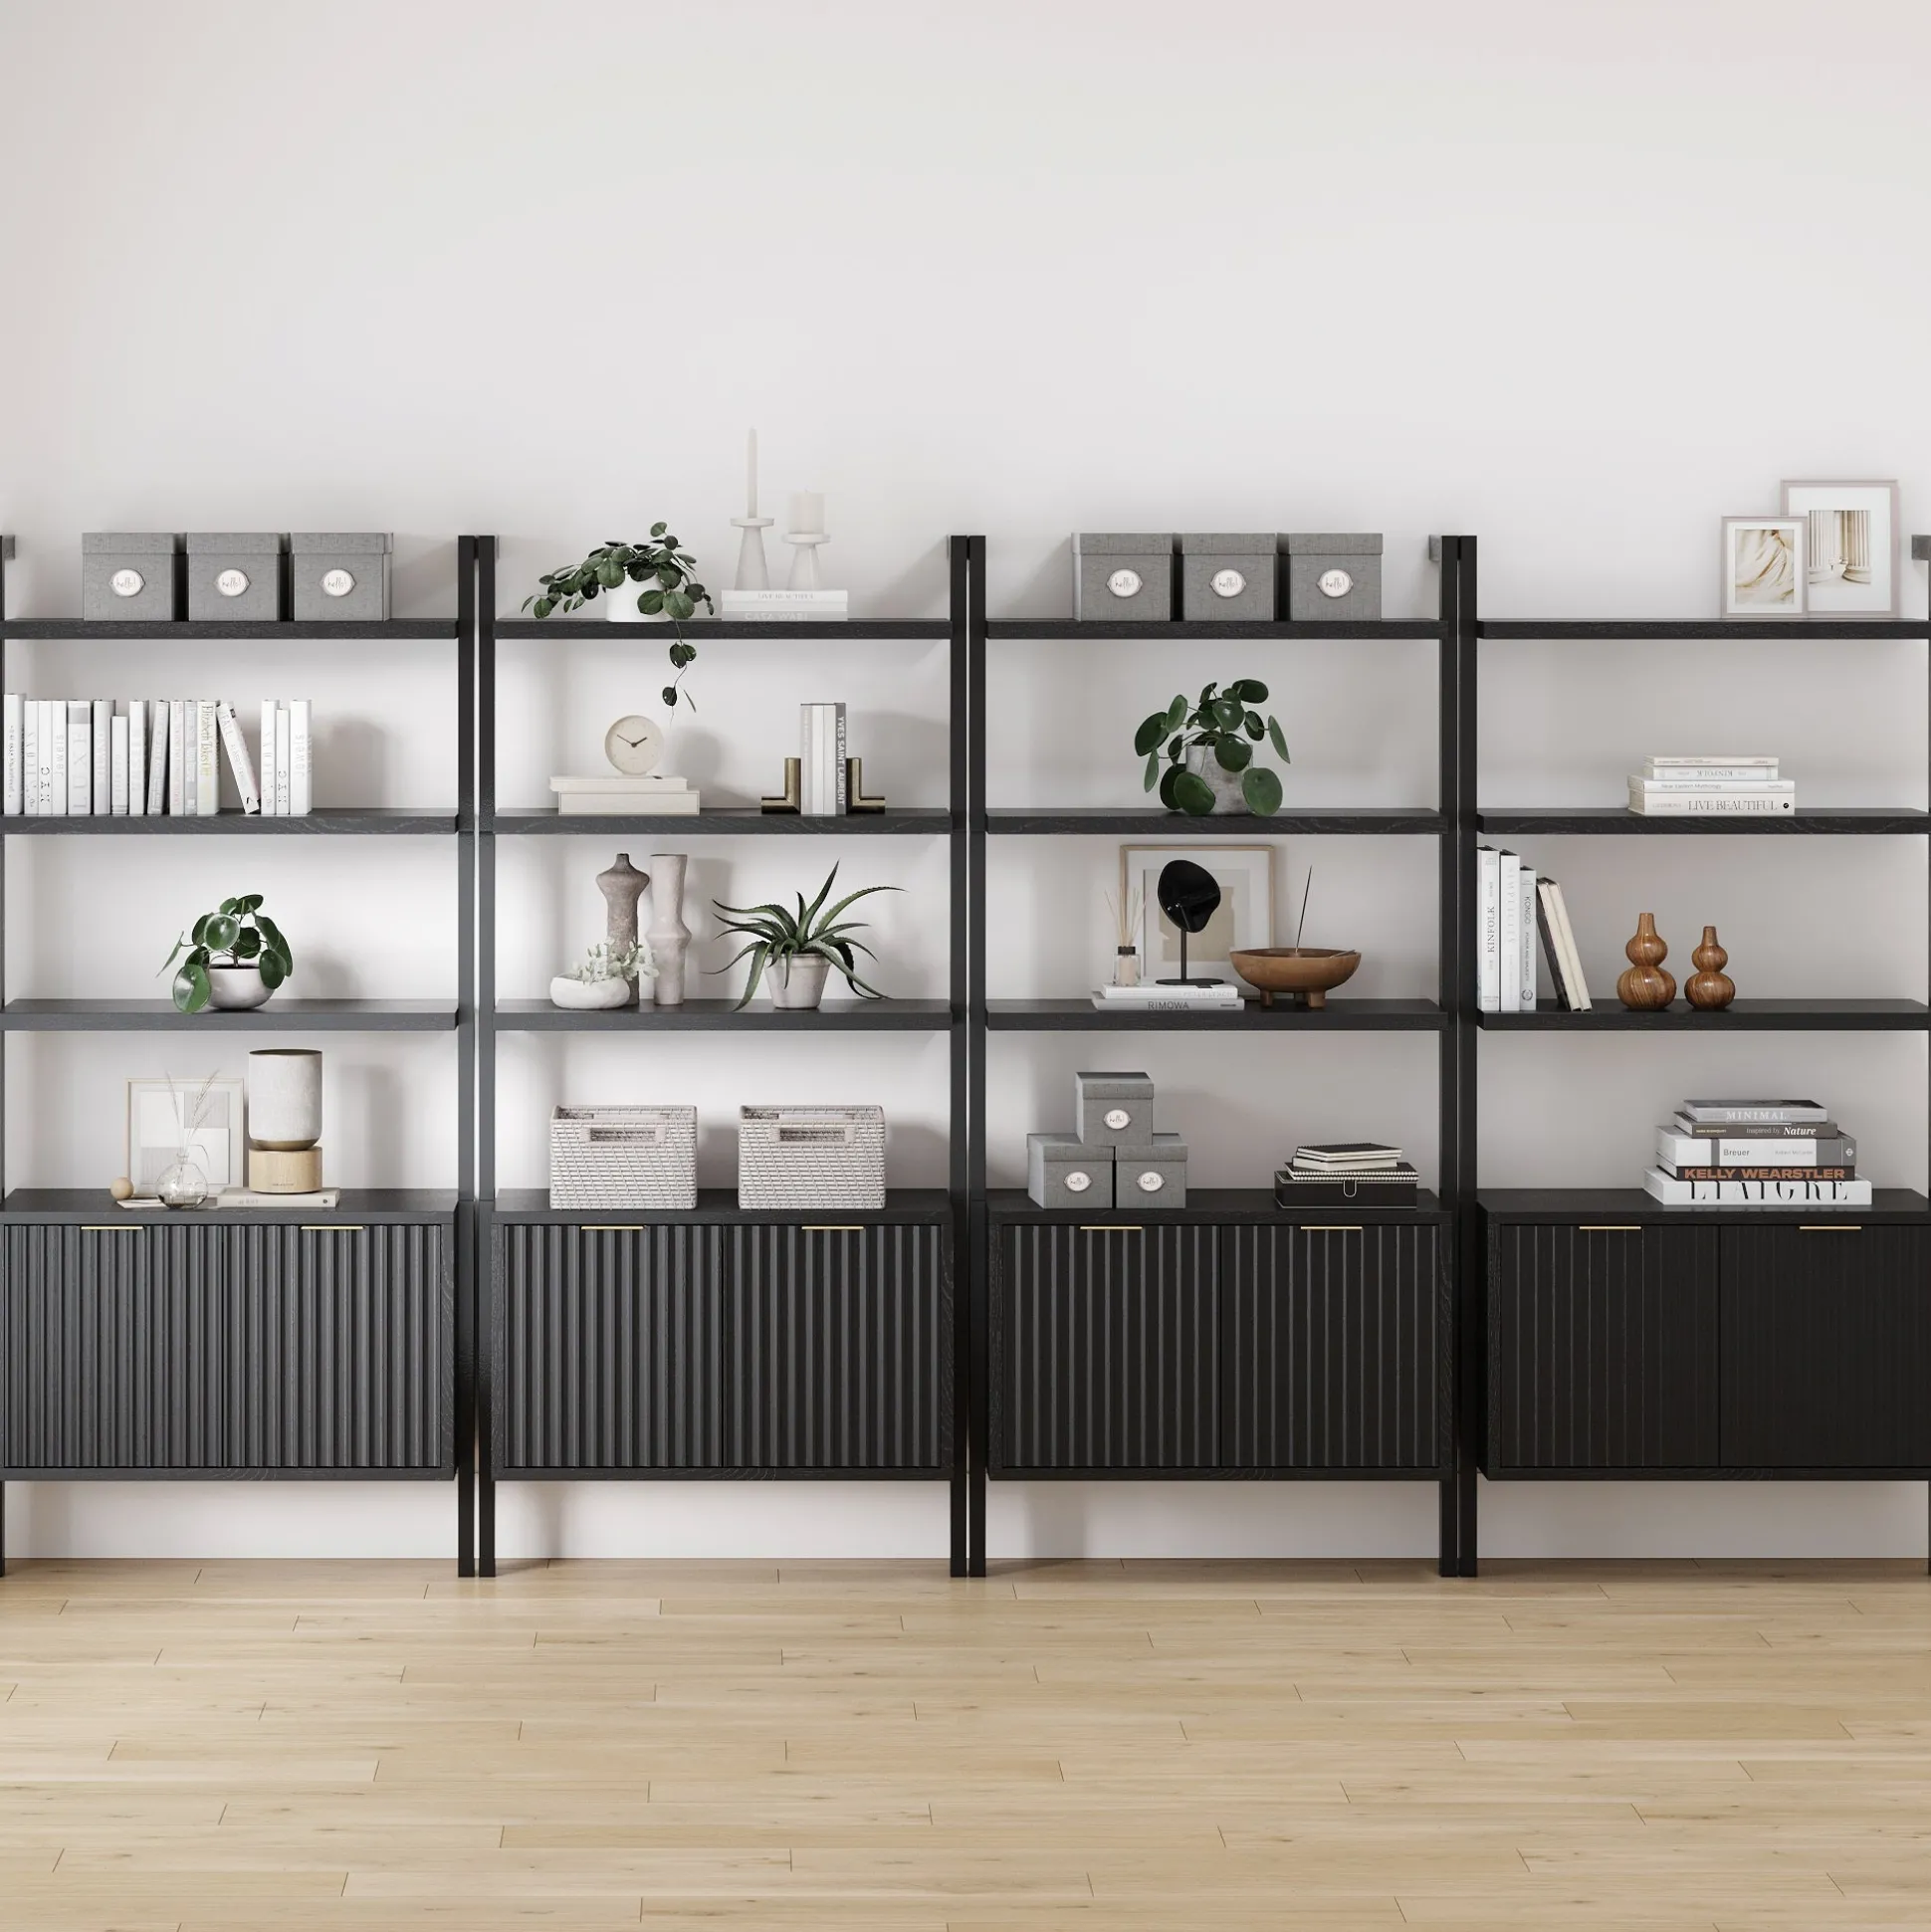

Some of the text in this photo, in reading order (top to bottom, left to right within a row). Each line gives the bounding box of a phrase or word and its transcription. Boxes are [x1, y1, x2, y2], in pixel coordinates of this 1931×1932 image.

[201, 705, 214, 741] Elizabeth
[201, 742, 212, 762] Takes
[73, 732, 88, 808] LUXE
[40, 766, 50, 802] NYC
[1688, 800, 1714, 810] LIVE
[1716, 800, 1778, 810] BEAUTIFUL
[1148, 1000, 1189, 1010] RIMOWA
[1725, 1110, 1788, 1121] MINIMAL
[1746, 1127, 1772, 1136] Inspired
[1783, 1127, 1817, 1136] Nature
[1723, 1148, 1750, 1157] Breuer
[1684, 1169, 1845, 1180] KELLY WEARSTLER
